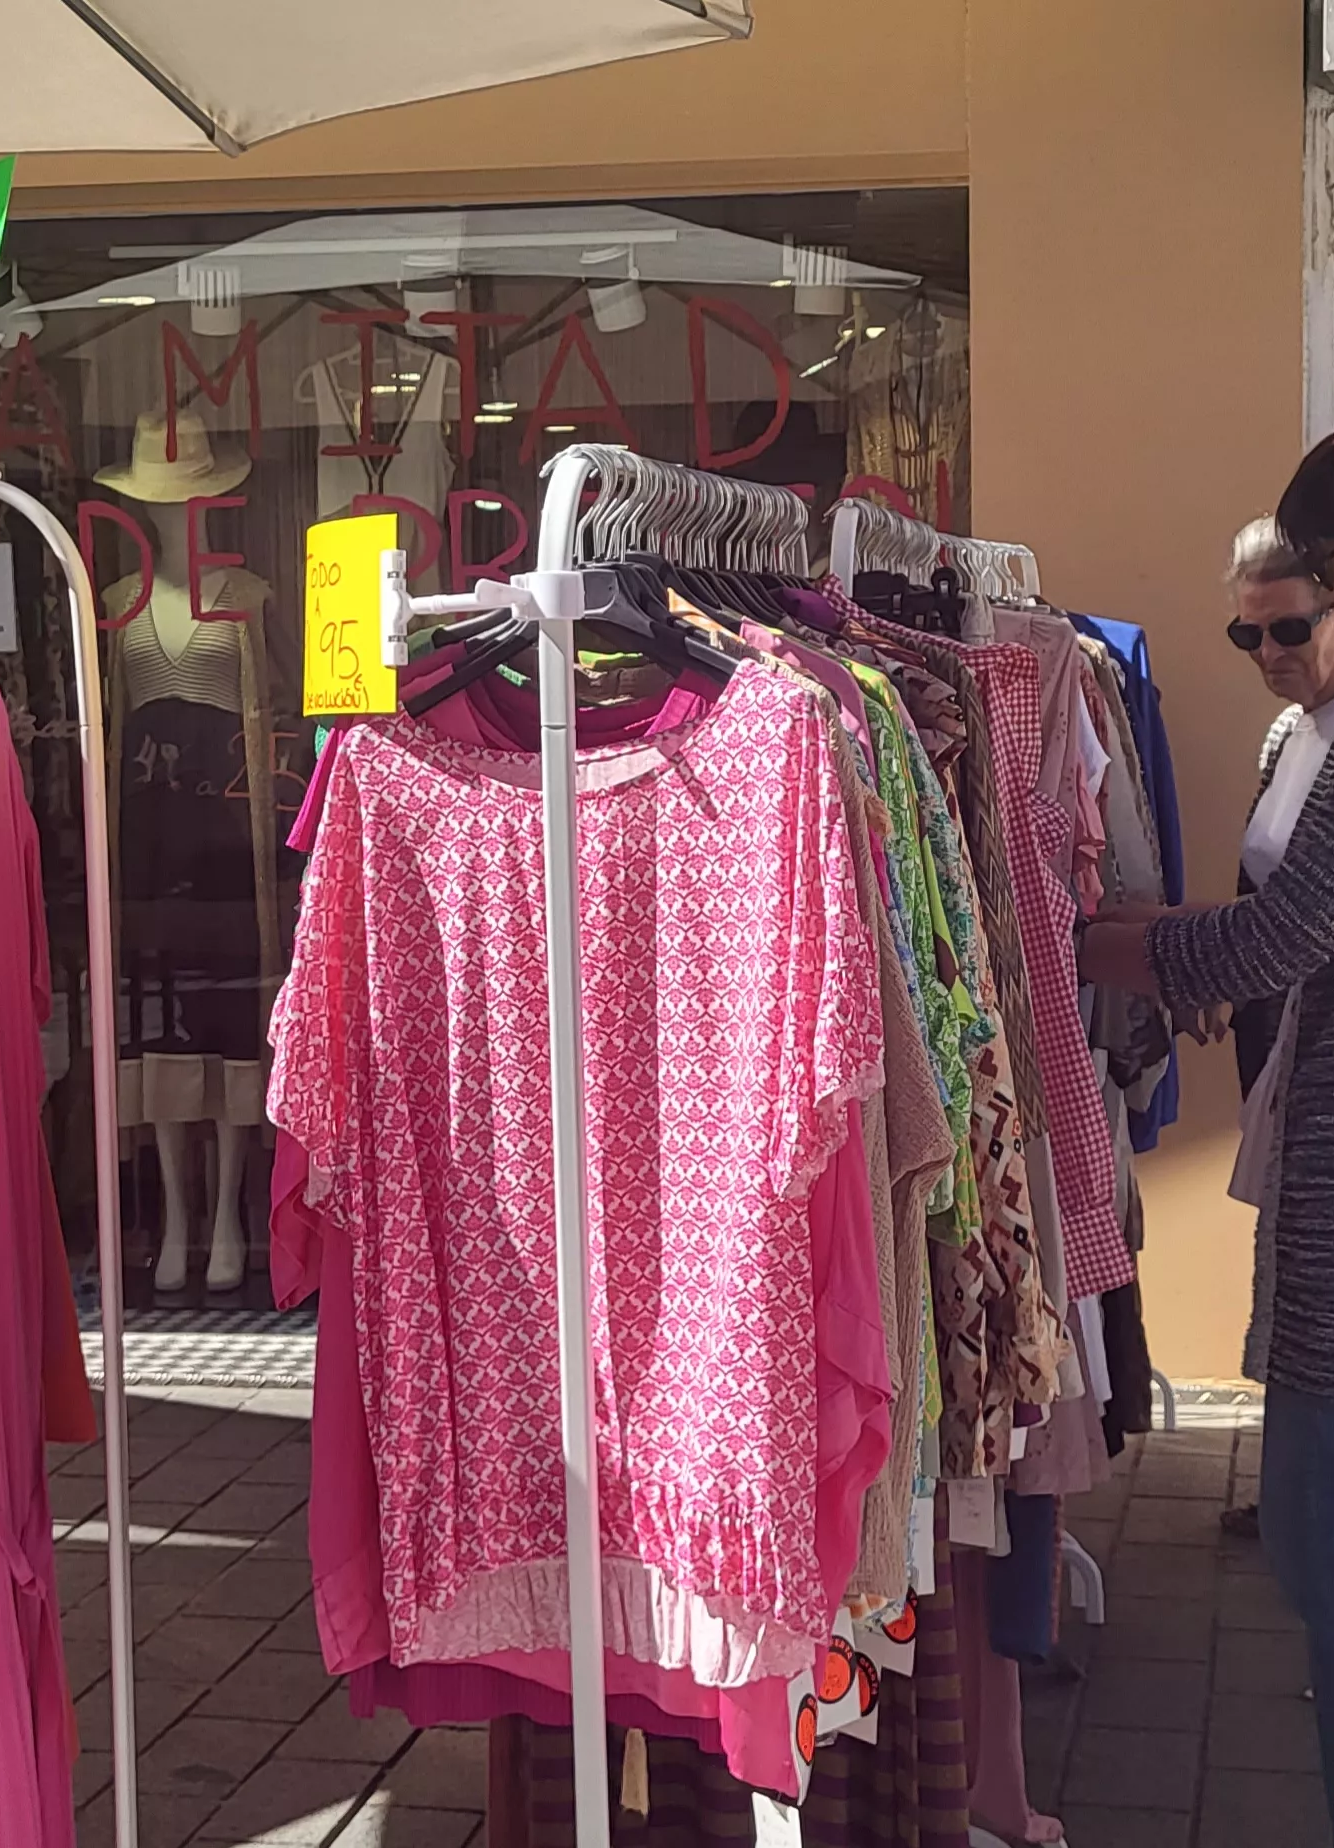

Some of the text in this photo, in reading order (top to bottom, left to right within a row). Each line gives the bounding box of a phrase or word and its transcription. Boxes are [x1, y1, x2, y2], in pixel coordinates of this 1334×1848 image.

[161, 296, 791, 470] MITAD
[77, 495, 252, 631] DE
[307, 553, 342, 589] ODO
